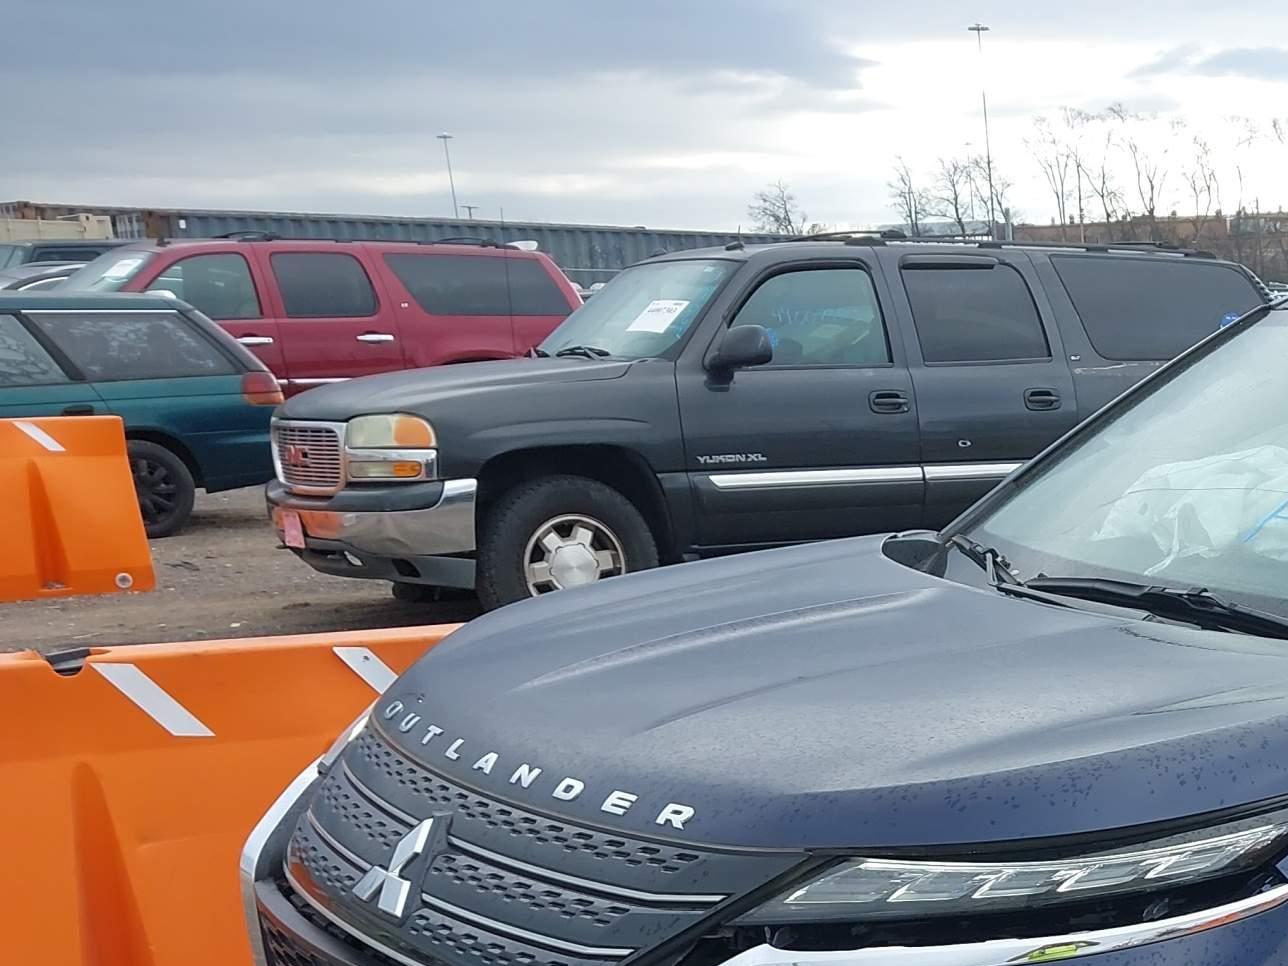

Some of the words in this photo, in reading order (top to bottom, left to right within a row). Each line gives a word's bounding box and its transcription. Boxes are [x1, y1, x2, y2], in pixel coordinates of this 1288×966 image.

[696, 454, 746, 464] YUKON
[747, 453, 767, 462] XL
[383, 700, 696, 830] OUTLANDER
